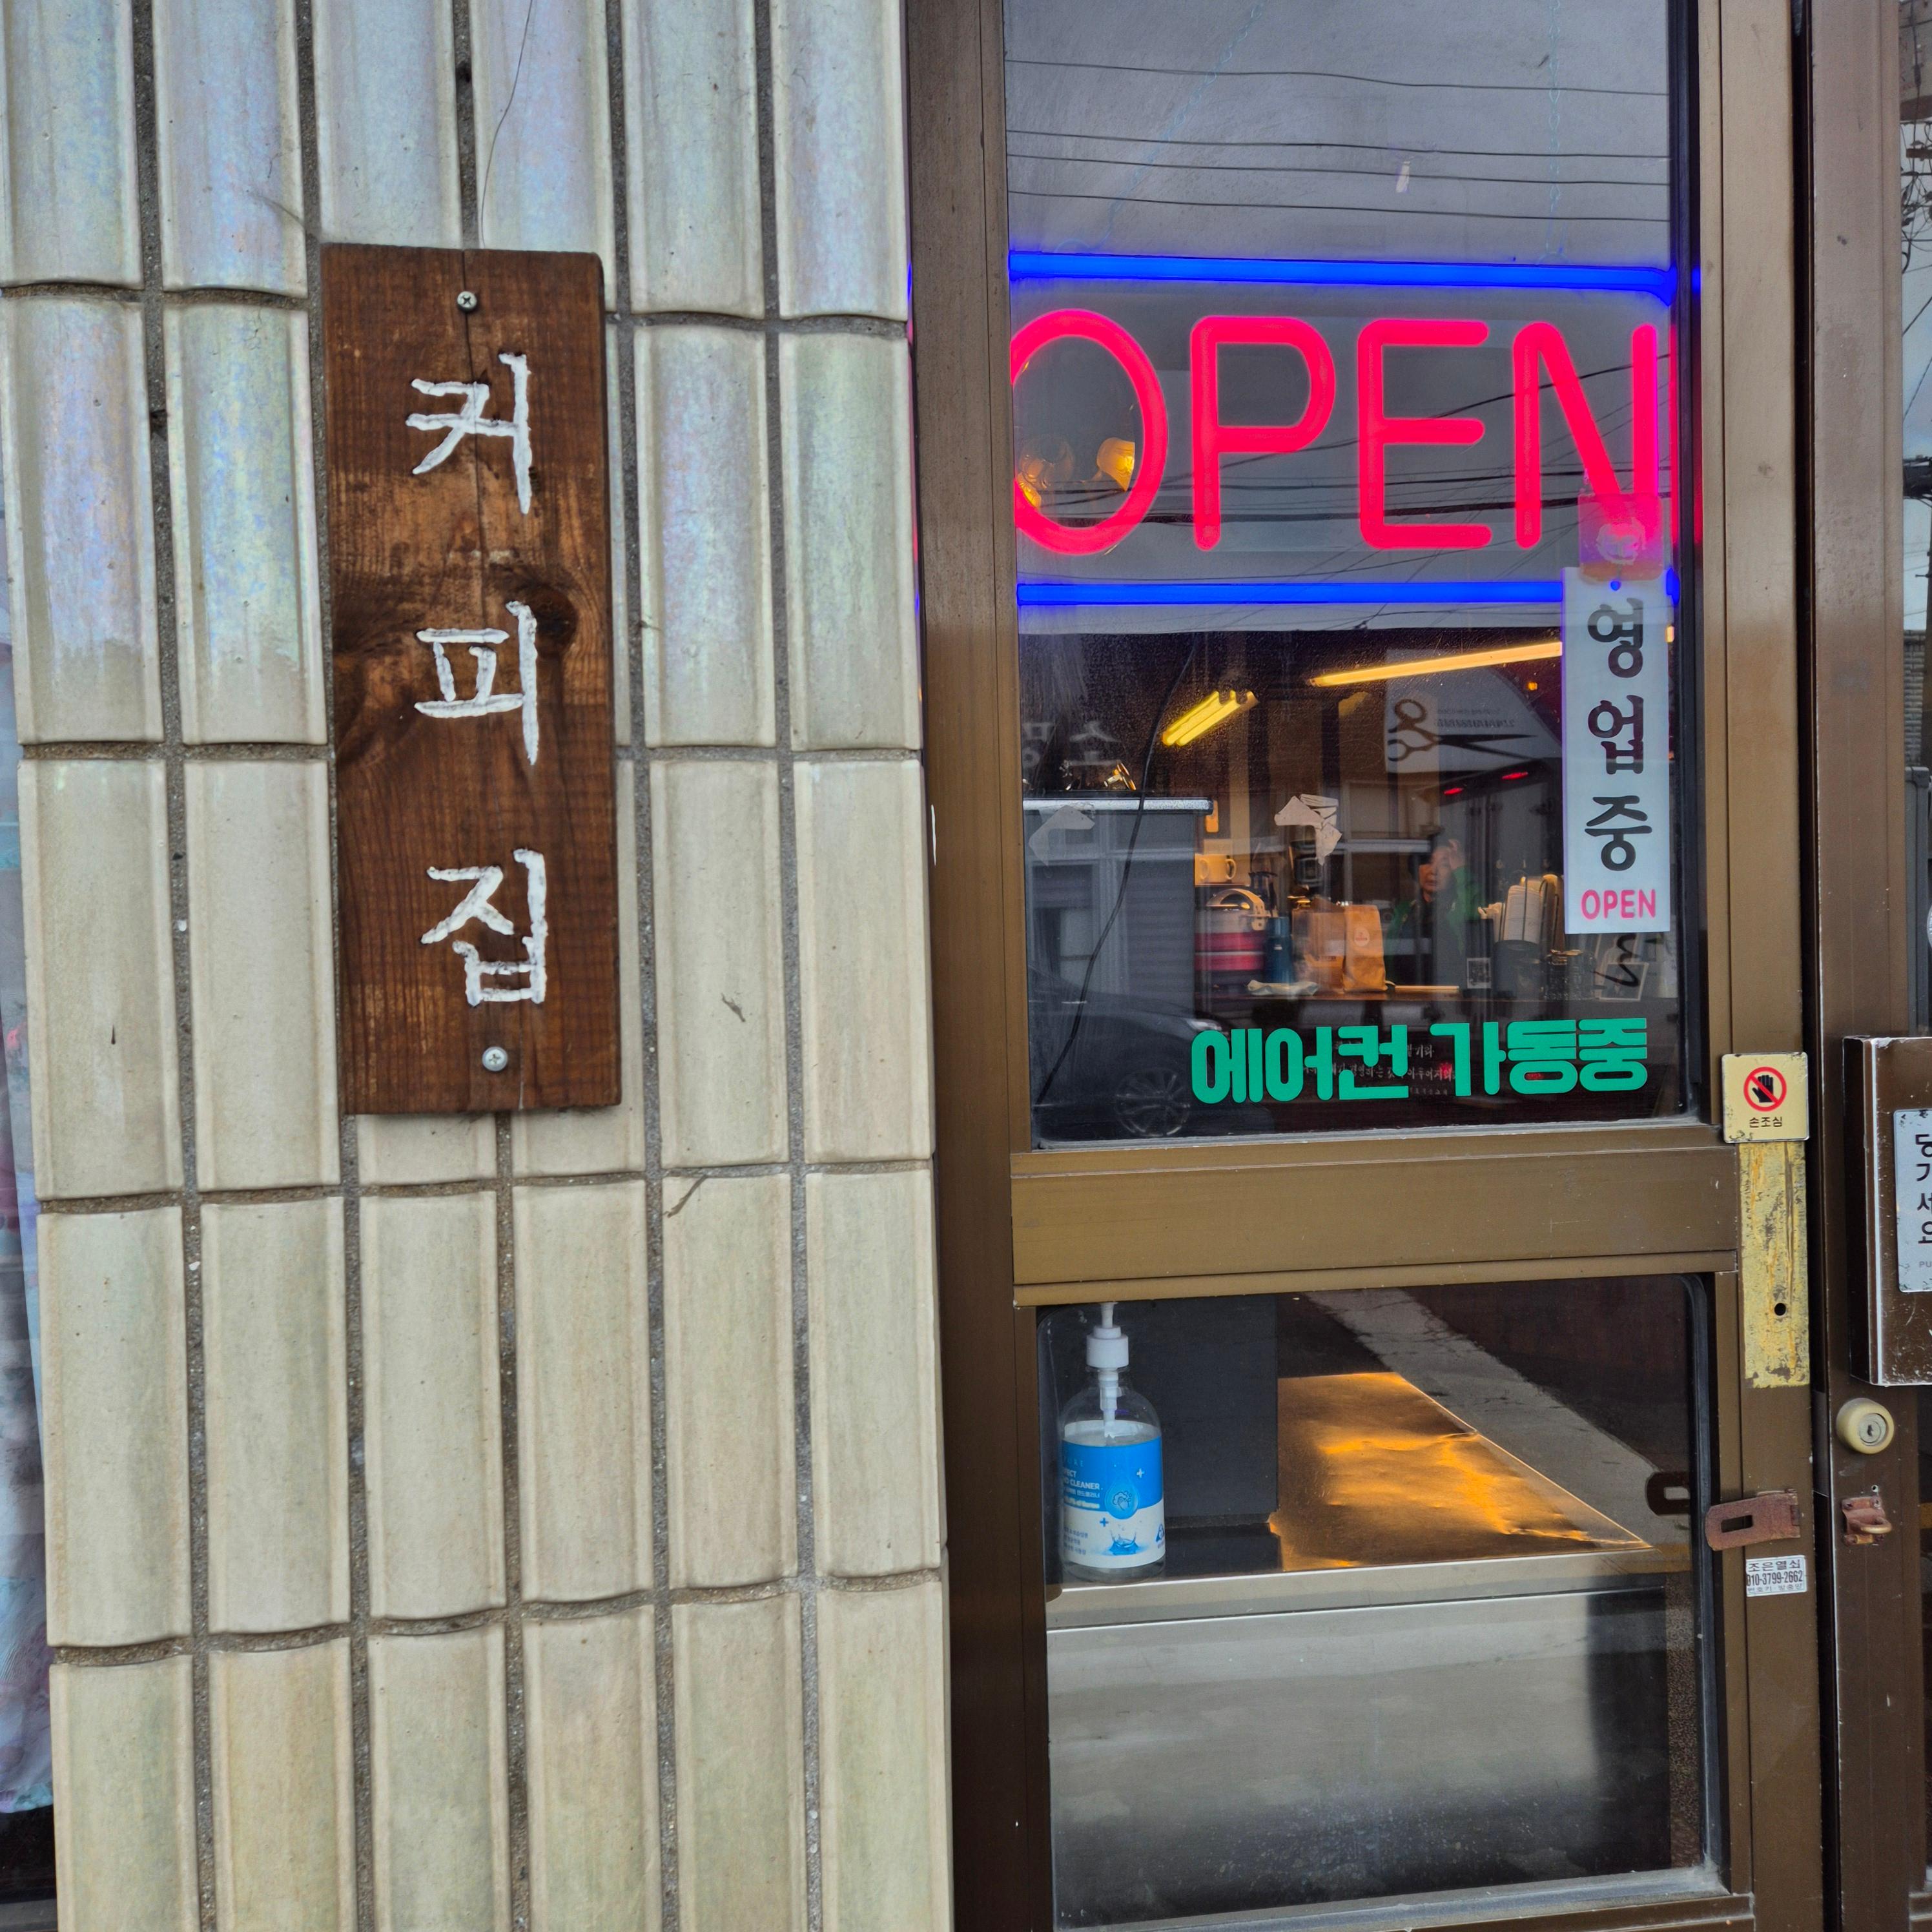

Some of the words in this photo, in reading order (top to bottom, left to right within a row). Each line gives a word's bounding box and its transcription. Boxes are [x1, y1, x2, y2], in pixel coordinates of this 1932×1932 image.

[1010, 308, 1659, 555] OPEN
[406, 352, 549, 1007] 커피집
[1584, 597, 1653, 872] 영업중
[1580, 889, 1657, 920] OPEN
[1191, 1024, 1409, 1104] 에어컨
[1429, 1017, 1648, 1096] 가동중
[1749, 1116, 1783, 1128] 손조심
[1746, 1570, 1804, 1587] 010-3799-2662
